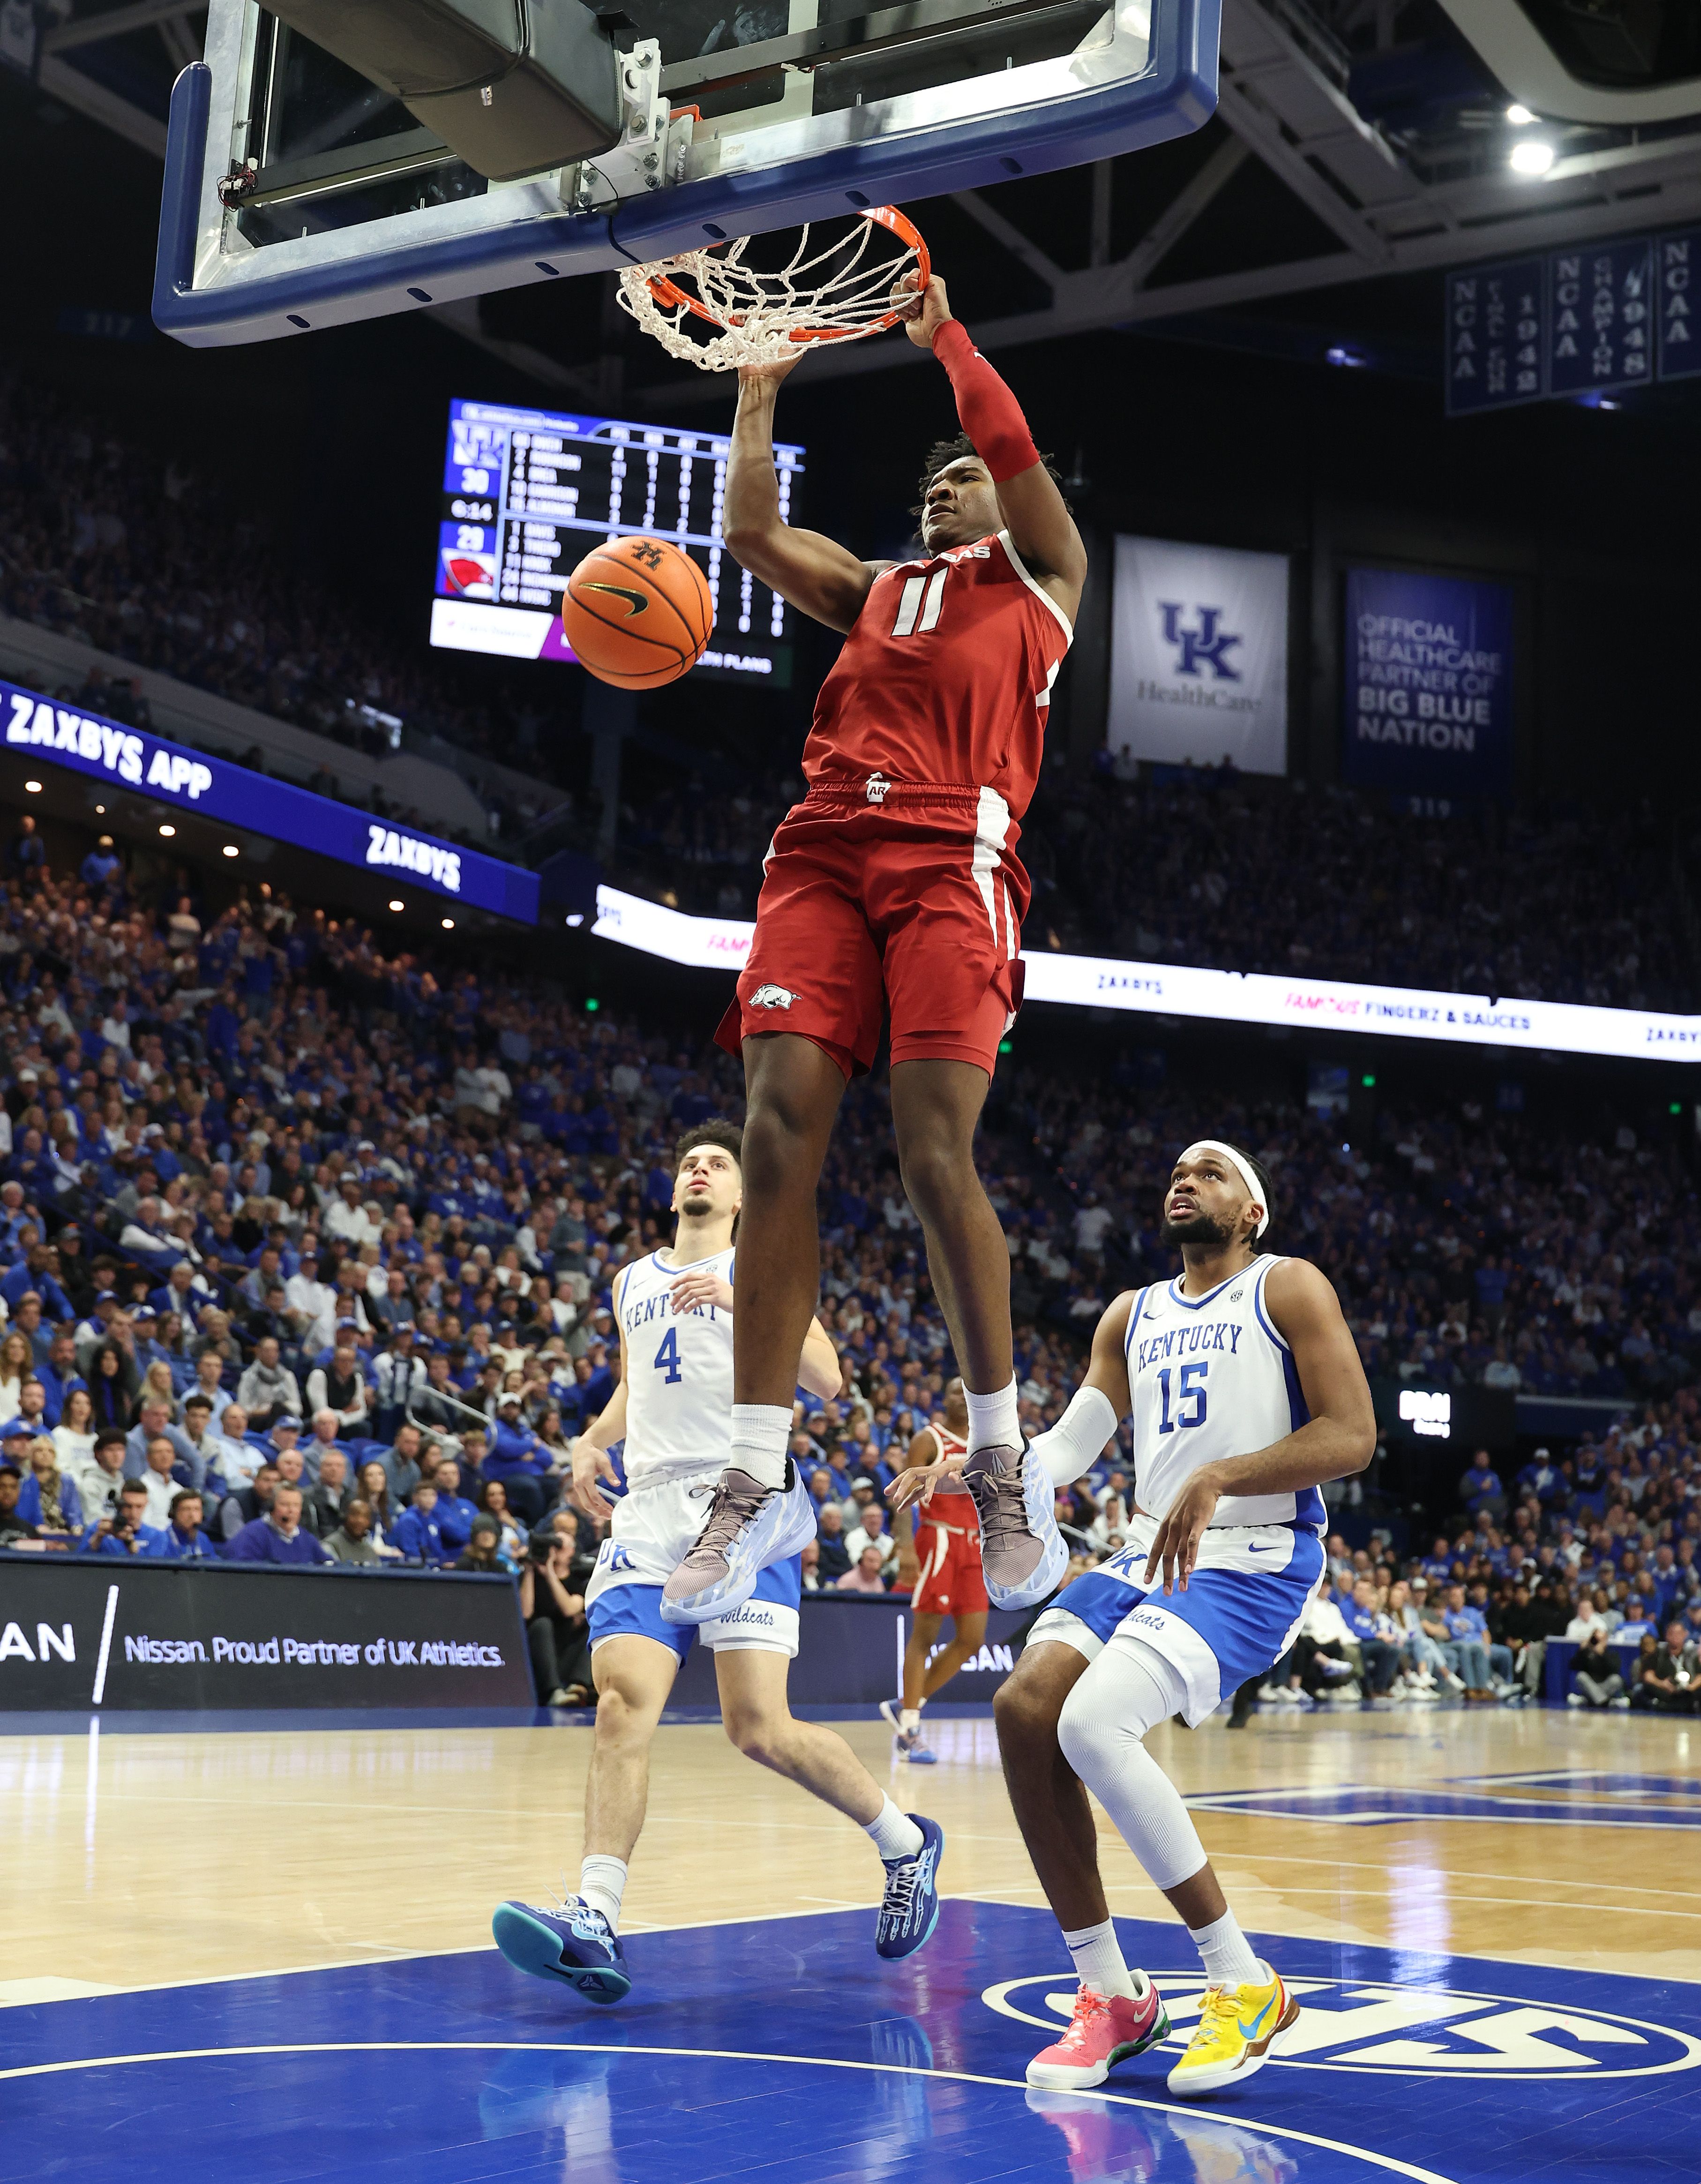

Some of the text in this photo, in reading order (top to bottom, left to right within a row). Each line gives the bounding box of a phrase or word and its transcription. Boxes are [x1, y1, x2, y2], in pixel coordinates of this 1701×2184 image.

[1556, 256, 1581, 358] NCAA
[891, 567, 949, 636] 11
[1158, 600, 1242, 680] UK
[1357, 613, 1458, 645] OFFICIAL
[1357, 640, 1501, 675] HEALTHCARE
[1357, 662, 1494, 696] PARTNER OF
[1357, 687, 1490, 725] BIG BLUE
[5, 693, 212, 800] ZAXBYS APP
[1357, 718, 1476, 752] NATION
[868, 786, 885, 796] AR
[366, 824, 460, 892] ZAXBYS
[1285, 992, 1530, 1030] FAMOUS FINGERZ & SAUCES
[654, 1327, 682, 1384] 4
[1139, 1324, 1242, 1373] KENTUCKY
[1157, 1362, 1208, 1434] 15
[124, 1635, 506, 1668] Nissan. Proud Partner of UK Athletics.
